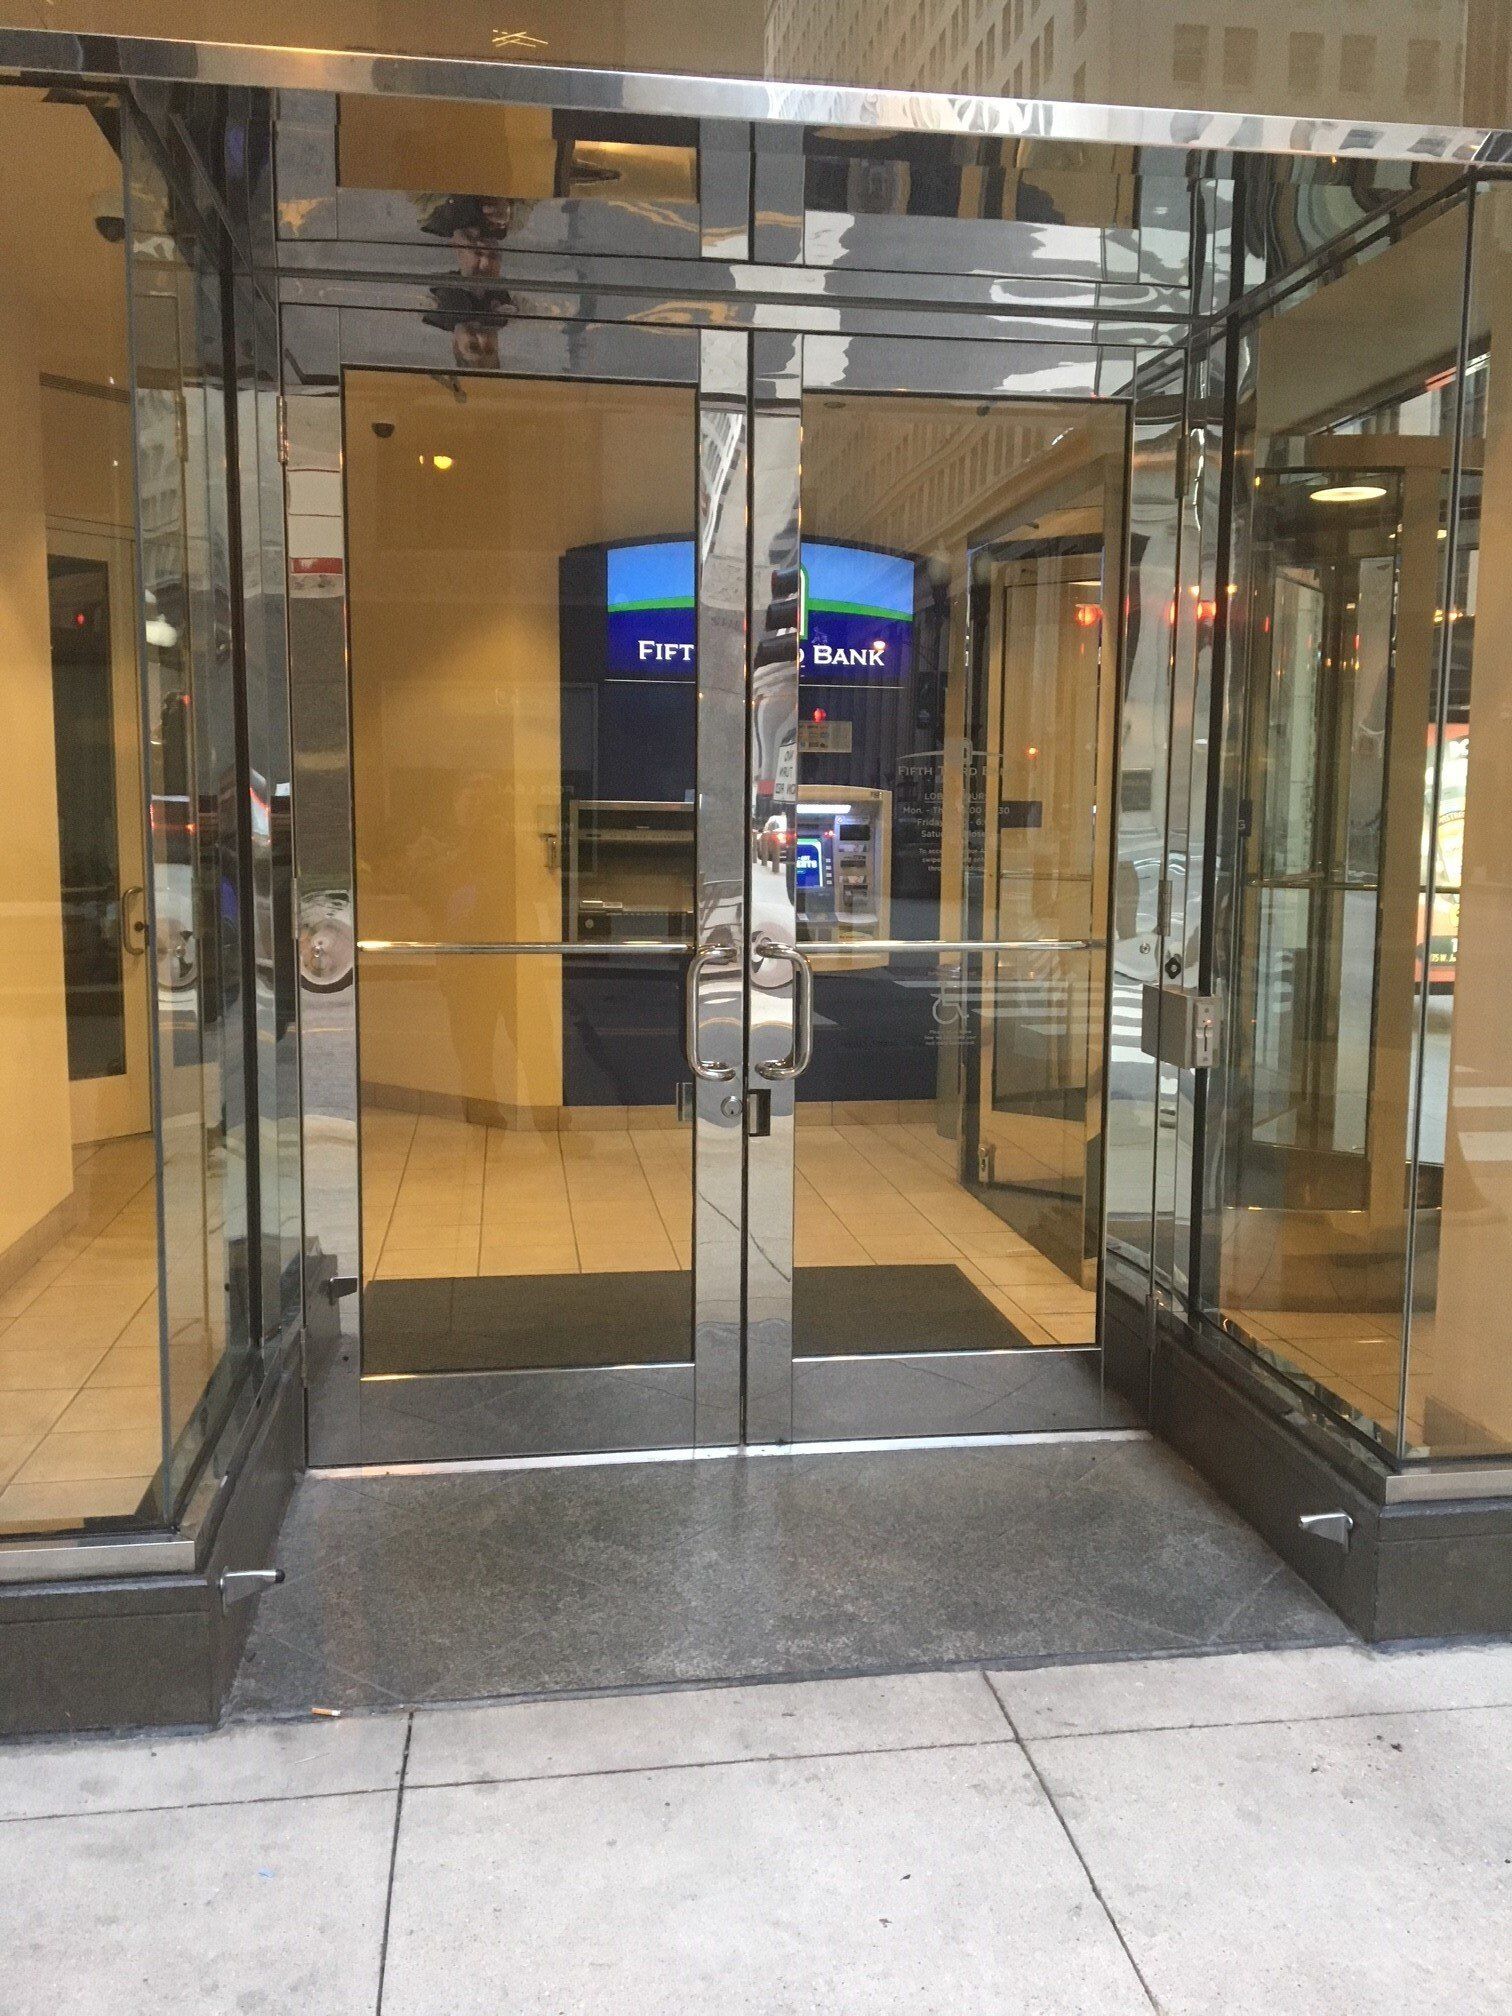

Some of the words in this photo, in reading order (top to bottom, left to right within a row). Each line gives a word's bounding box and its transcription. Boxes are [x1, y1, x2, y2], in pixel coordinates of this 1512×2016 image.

[638, 640, 695, 661] FIFT
[812, 645, 885, 666] BANK
[898, 766, 933, 776] FIFTH
